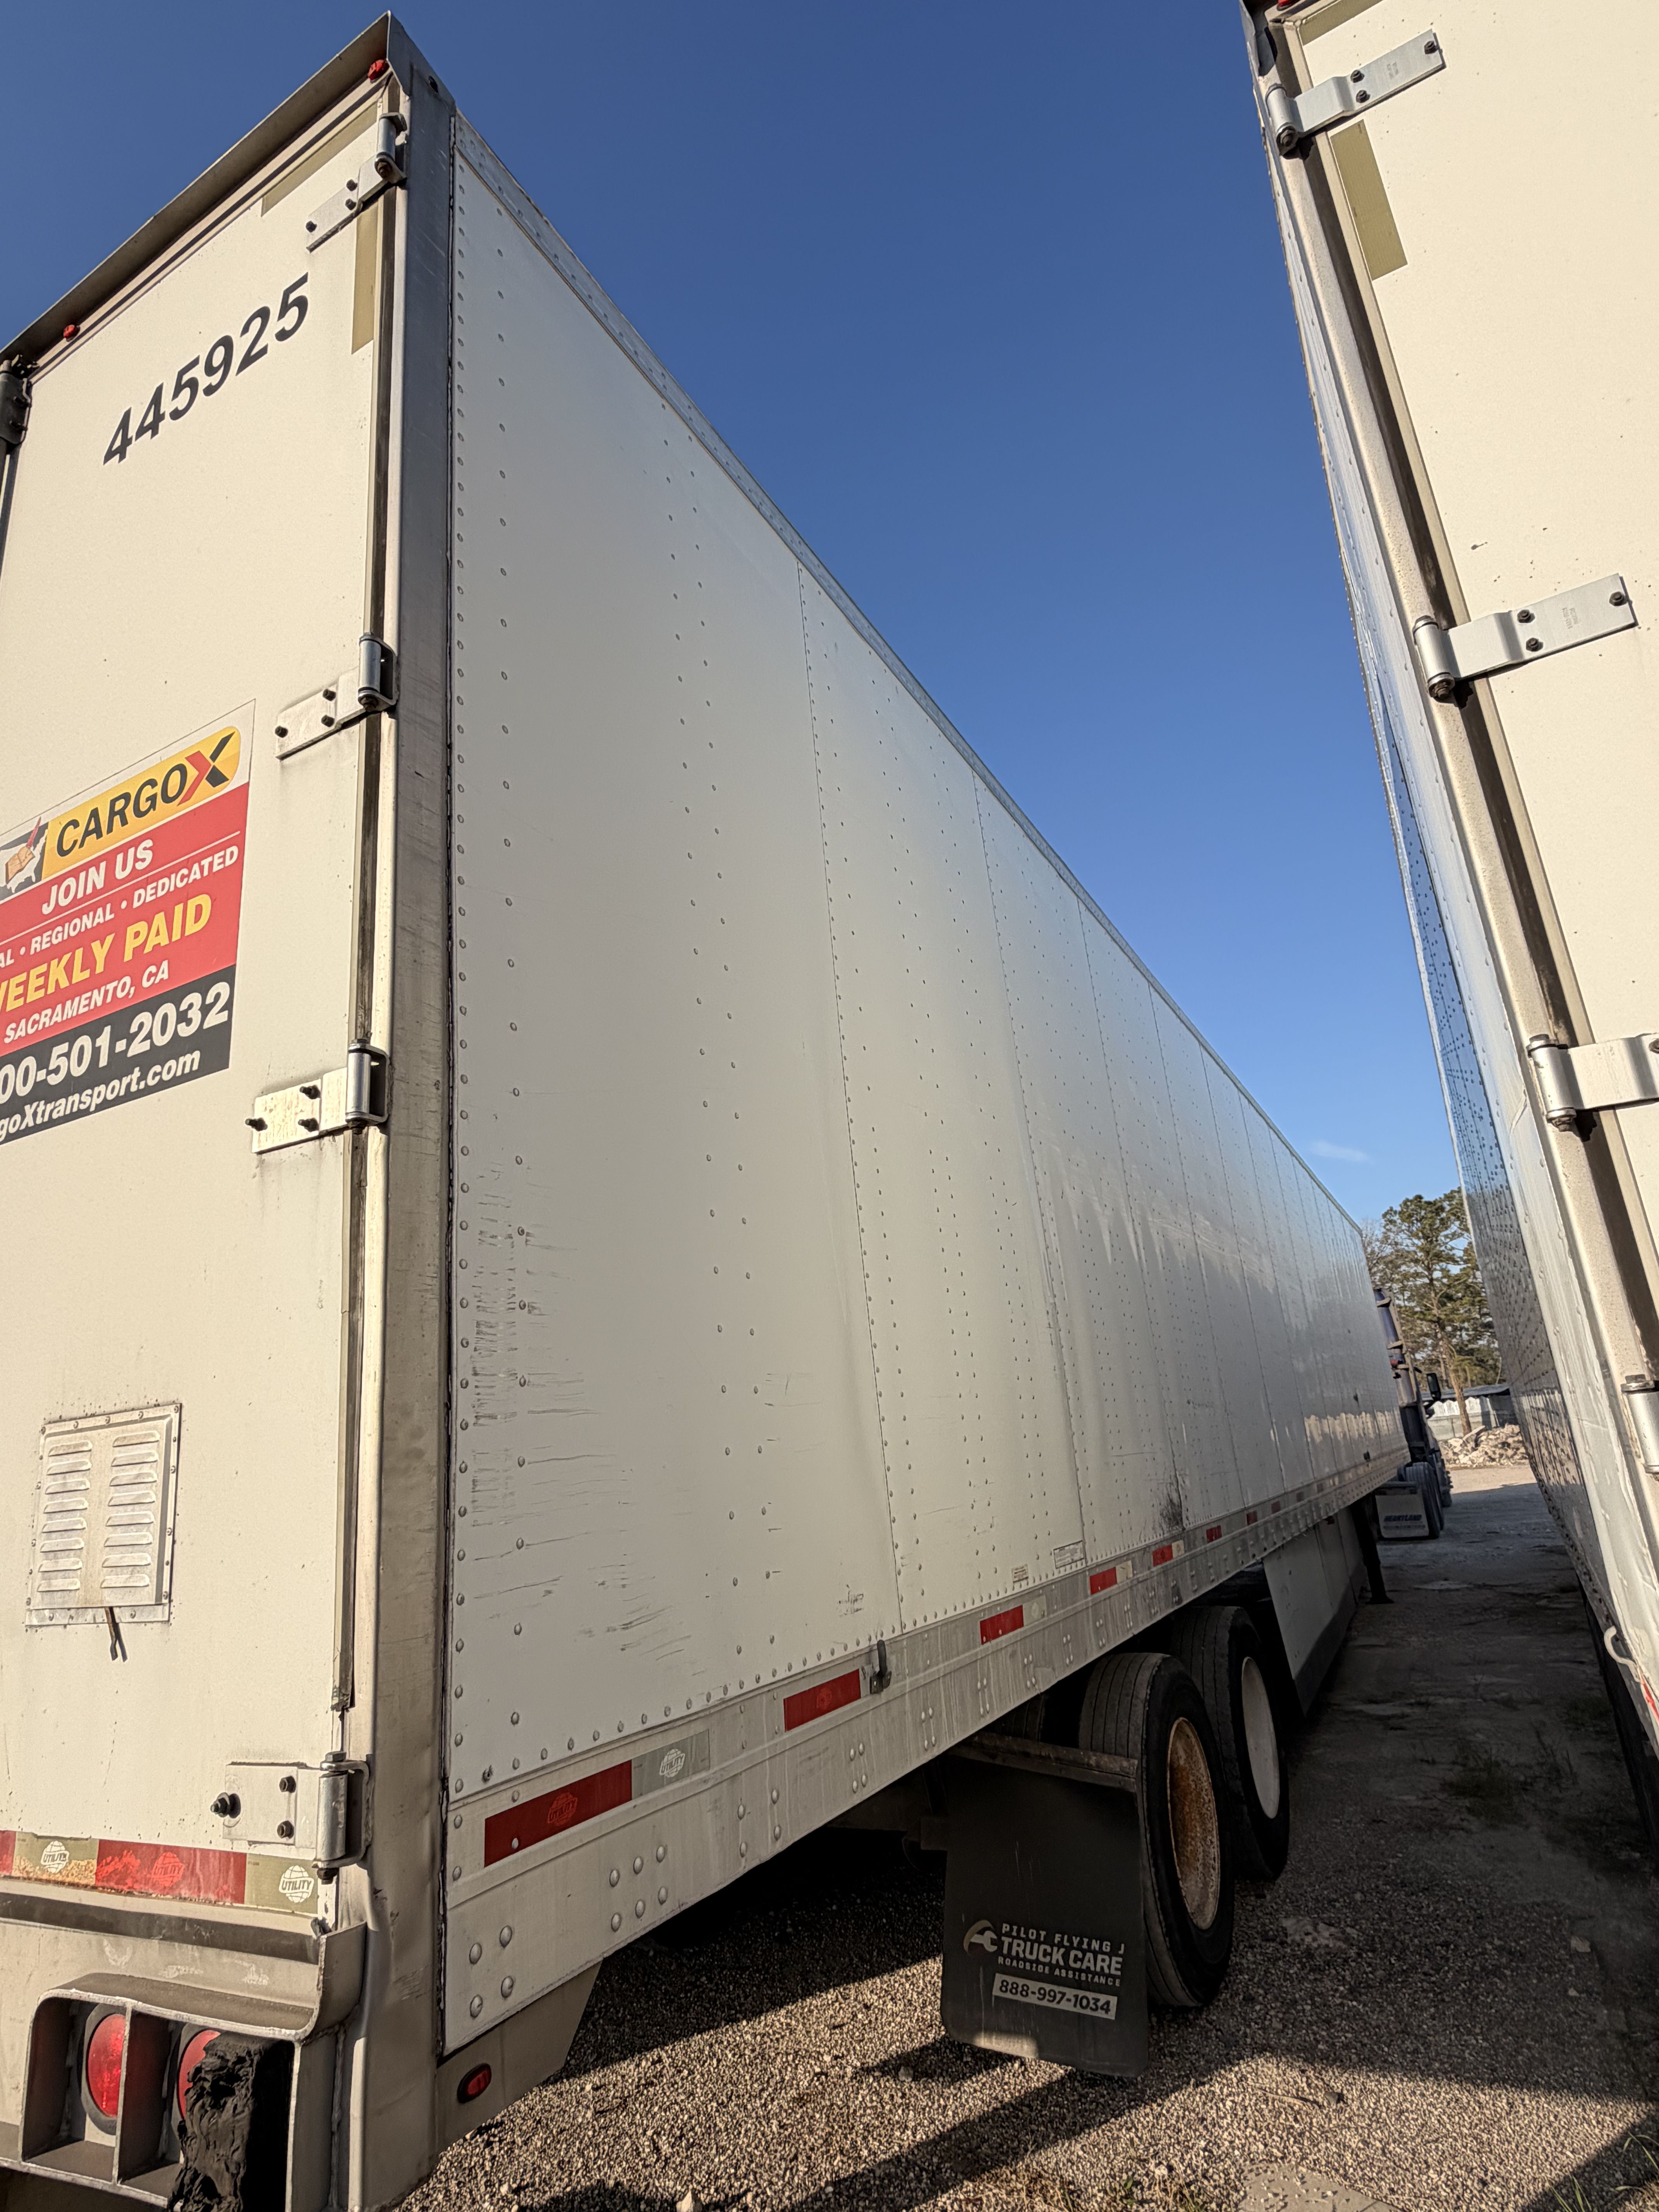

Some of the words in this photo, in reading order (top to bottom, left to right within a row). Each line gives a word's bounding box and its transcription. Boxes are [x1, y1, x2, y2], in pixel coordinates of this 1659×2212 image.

[103, 272, 308, 465] 445925
[57, 731, 235, 857] CARGOX
[30, 904, 115, 955] REGIONAL
[133, 845, 239, 908] DEDICATED
[42, 860, 106, 915] JOIN
[115, 839, 153, 879] US
[123, 894, 212, 962] PAID
[4, 976, 135, 1044] SACRAMENTO,
[141, 960, 169, 988] CA
[0, 982, 230, 1104] 00-501-2032
[0, 1050, 201, 1142] goXtransport.com
[281, 1879, 312, 1891] UTILITY
[998, 1956, 1049, 1974] ROADSIDE
[1054, 1968, 1121, 1987] ASSISTANCE
[1001, 1937, 1065, 1966] TRUCK
[1069, 1950, 1123, 1975] CARE
[1002, 1923, 1046, 1941] PILOT
[1054, 1934, 1111, 1952] FLYING
[1118, 1943, 1125, 1954] J
[999, 1980, 1111, 2014] 888-997-1034
